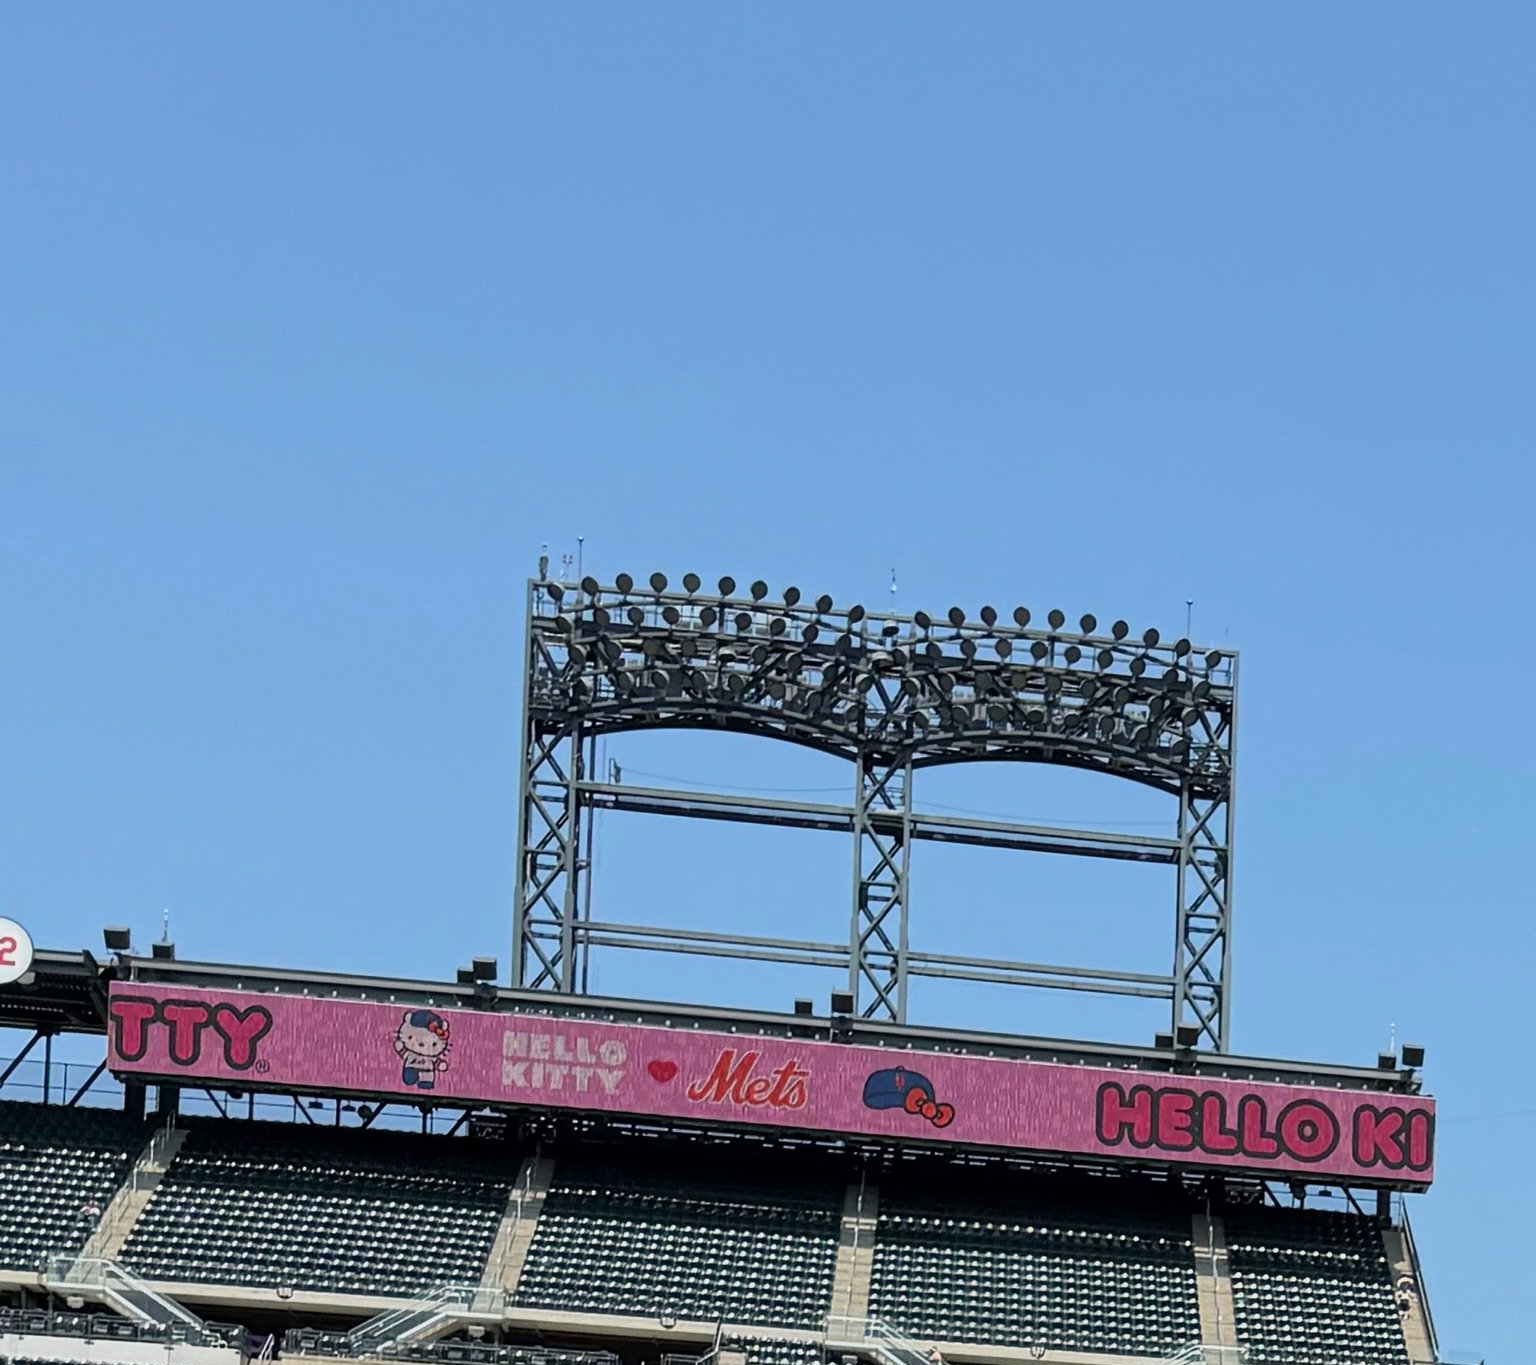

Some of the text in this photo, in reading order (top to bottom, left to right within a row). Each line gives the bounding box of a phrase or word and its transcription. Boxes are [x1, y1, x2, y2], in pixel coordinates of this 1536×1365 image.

[110, 995, 273, 1070] TTY
[502, 1031, 627, 1066] HELLO
[502, 1049, 810, 1109] KITTY Mets
[1097, 1081, 1434, 1174] HELLO KI
